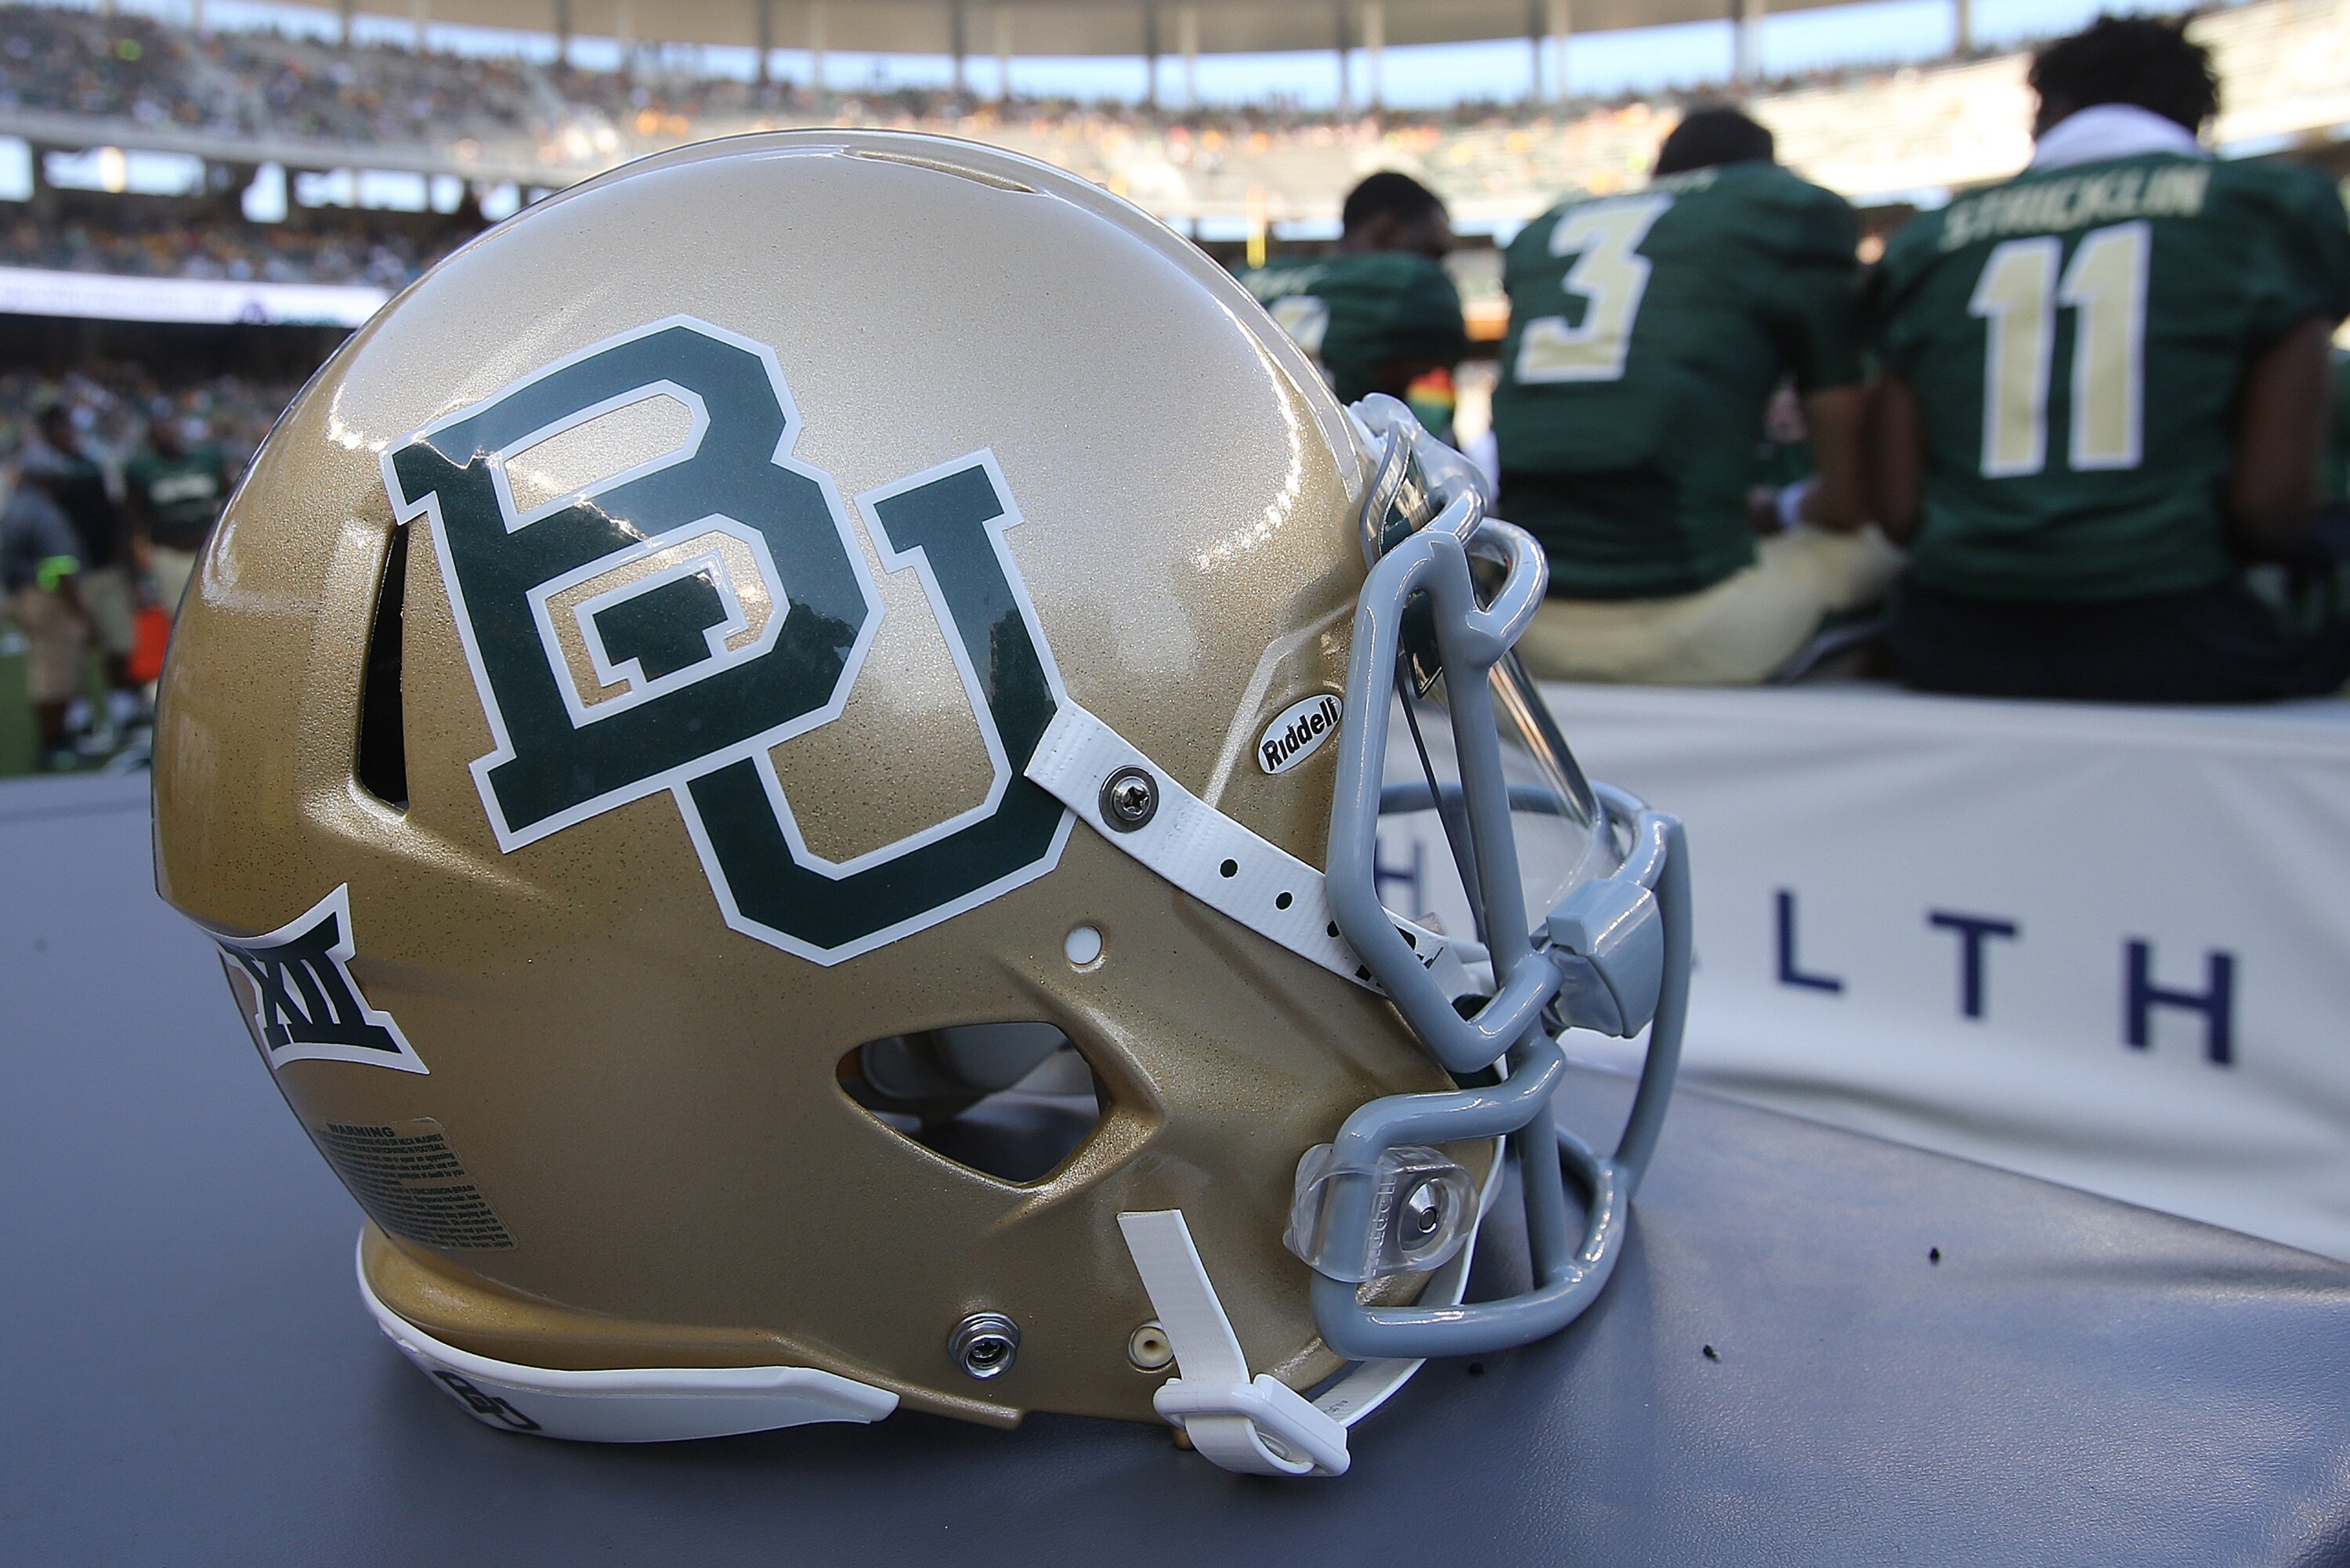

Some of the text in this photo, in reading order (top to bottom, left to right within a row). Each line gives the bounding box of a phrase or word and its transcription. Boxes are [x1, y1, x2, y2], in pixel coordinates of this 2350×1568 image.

[1938, 163, 2211, 253] STRICKLIN
[1513, 192, 1677, 384] 3
[1966, 219, 2153, 479] 11
[380, 314, 1076, 966] BU
[1261, 696, 1339, 771] Riddell
[326, 1122, 396, 1137] WARNING
[415, 1143, 446, 1154] FOOTBALL
